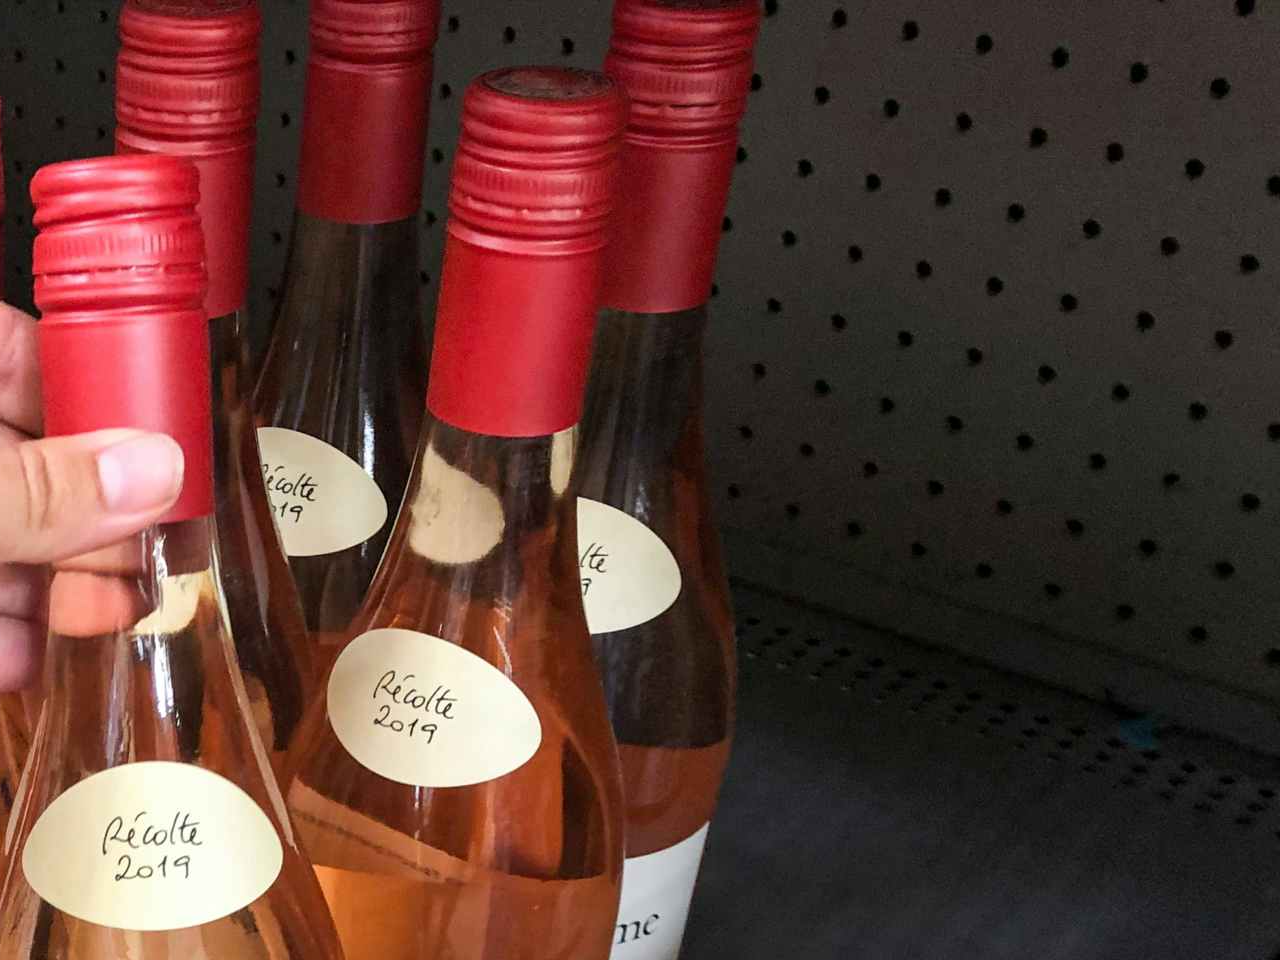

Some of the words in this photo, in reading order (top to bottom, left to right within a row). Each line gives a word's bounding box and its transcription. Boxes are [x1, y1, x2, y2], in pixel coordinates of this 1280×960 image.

[373, 669, 458, 720] Récolte
[373, 705, 438, 745] 2019
[102, 810, 204, 856] Récolte
[114, 854, 192, 882] 2019
